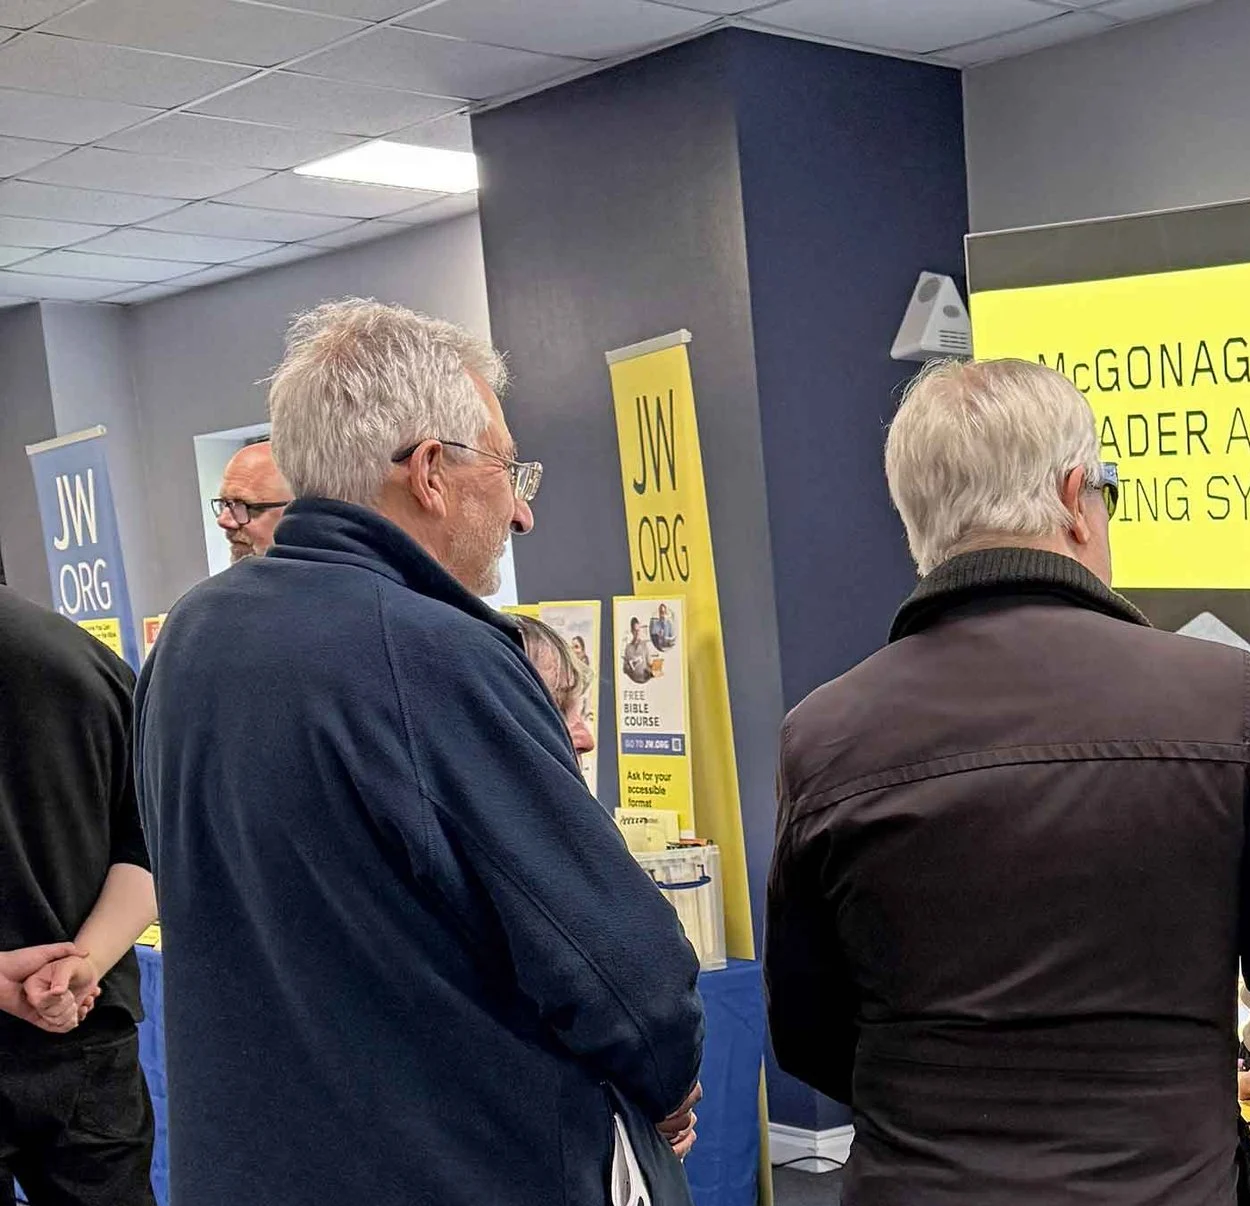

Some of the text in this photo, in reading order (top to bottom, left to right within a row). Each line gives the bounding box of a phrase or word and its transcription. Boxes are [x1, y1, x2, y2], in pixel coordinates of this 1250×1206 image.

[632, 388, 678, 496] JW
[53, 468, 98, 550] JW
[635, 513, 690, 582] .ORG
[623, 690, 646, 700] FREE
[624, 703, 649, 714] BIBLE
[624, 716, 660, 727] COURSE
[627, 771, 672, 784] Ask for your
[627, 786, 666, 796] accessible
[627, 798, 652, 808] format
